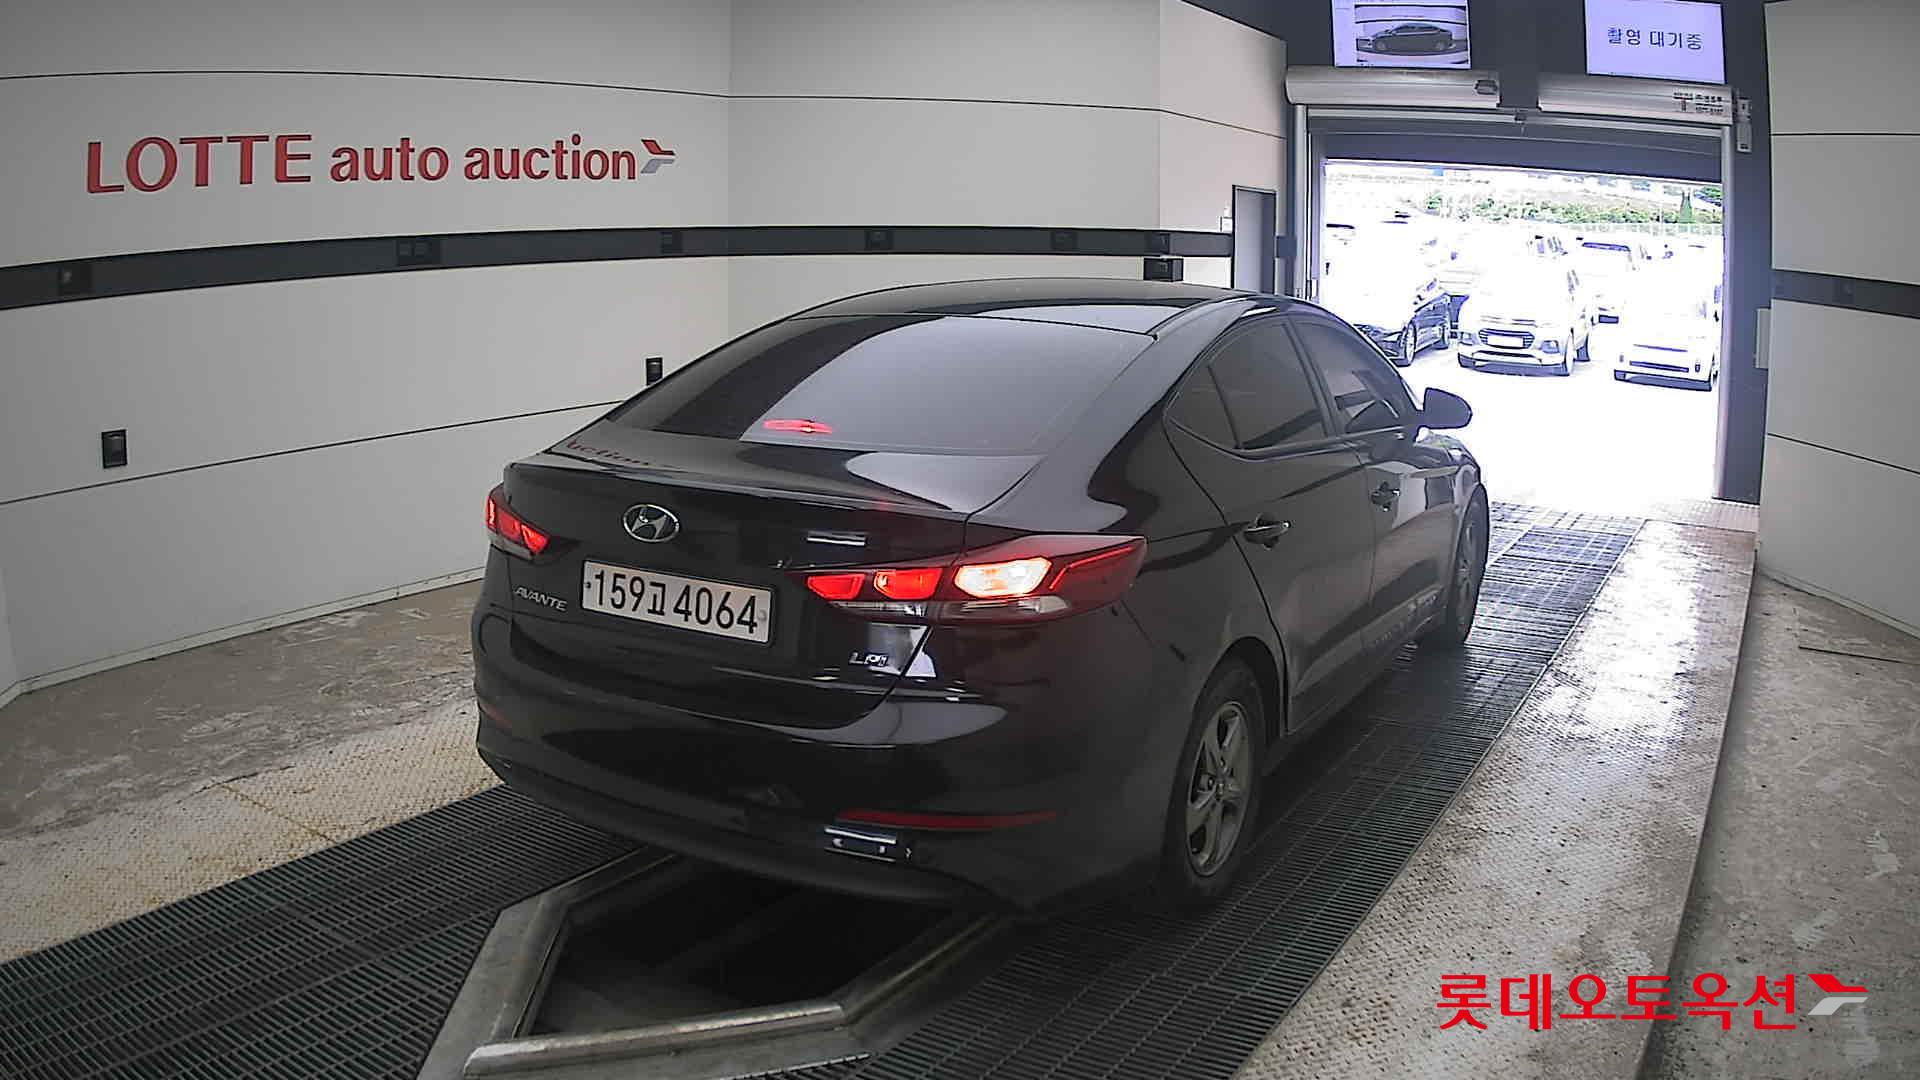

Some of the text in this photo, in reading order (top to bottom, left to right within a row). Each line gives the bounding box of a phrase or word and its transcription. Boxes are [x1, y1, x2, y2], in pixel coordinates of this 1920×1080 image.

[87, 134, 637, 193] LOTTE auto auction
[514, 587, 568, 611] AVANTE
